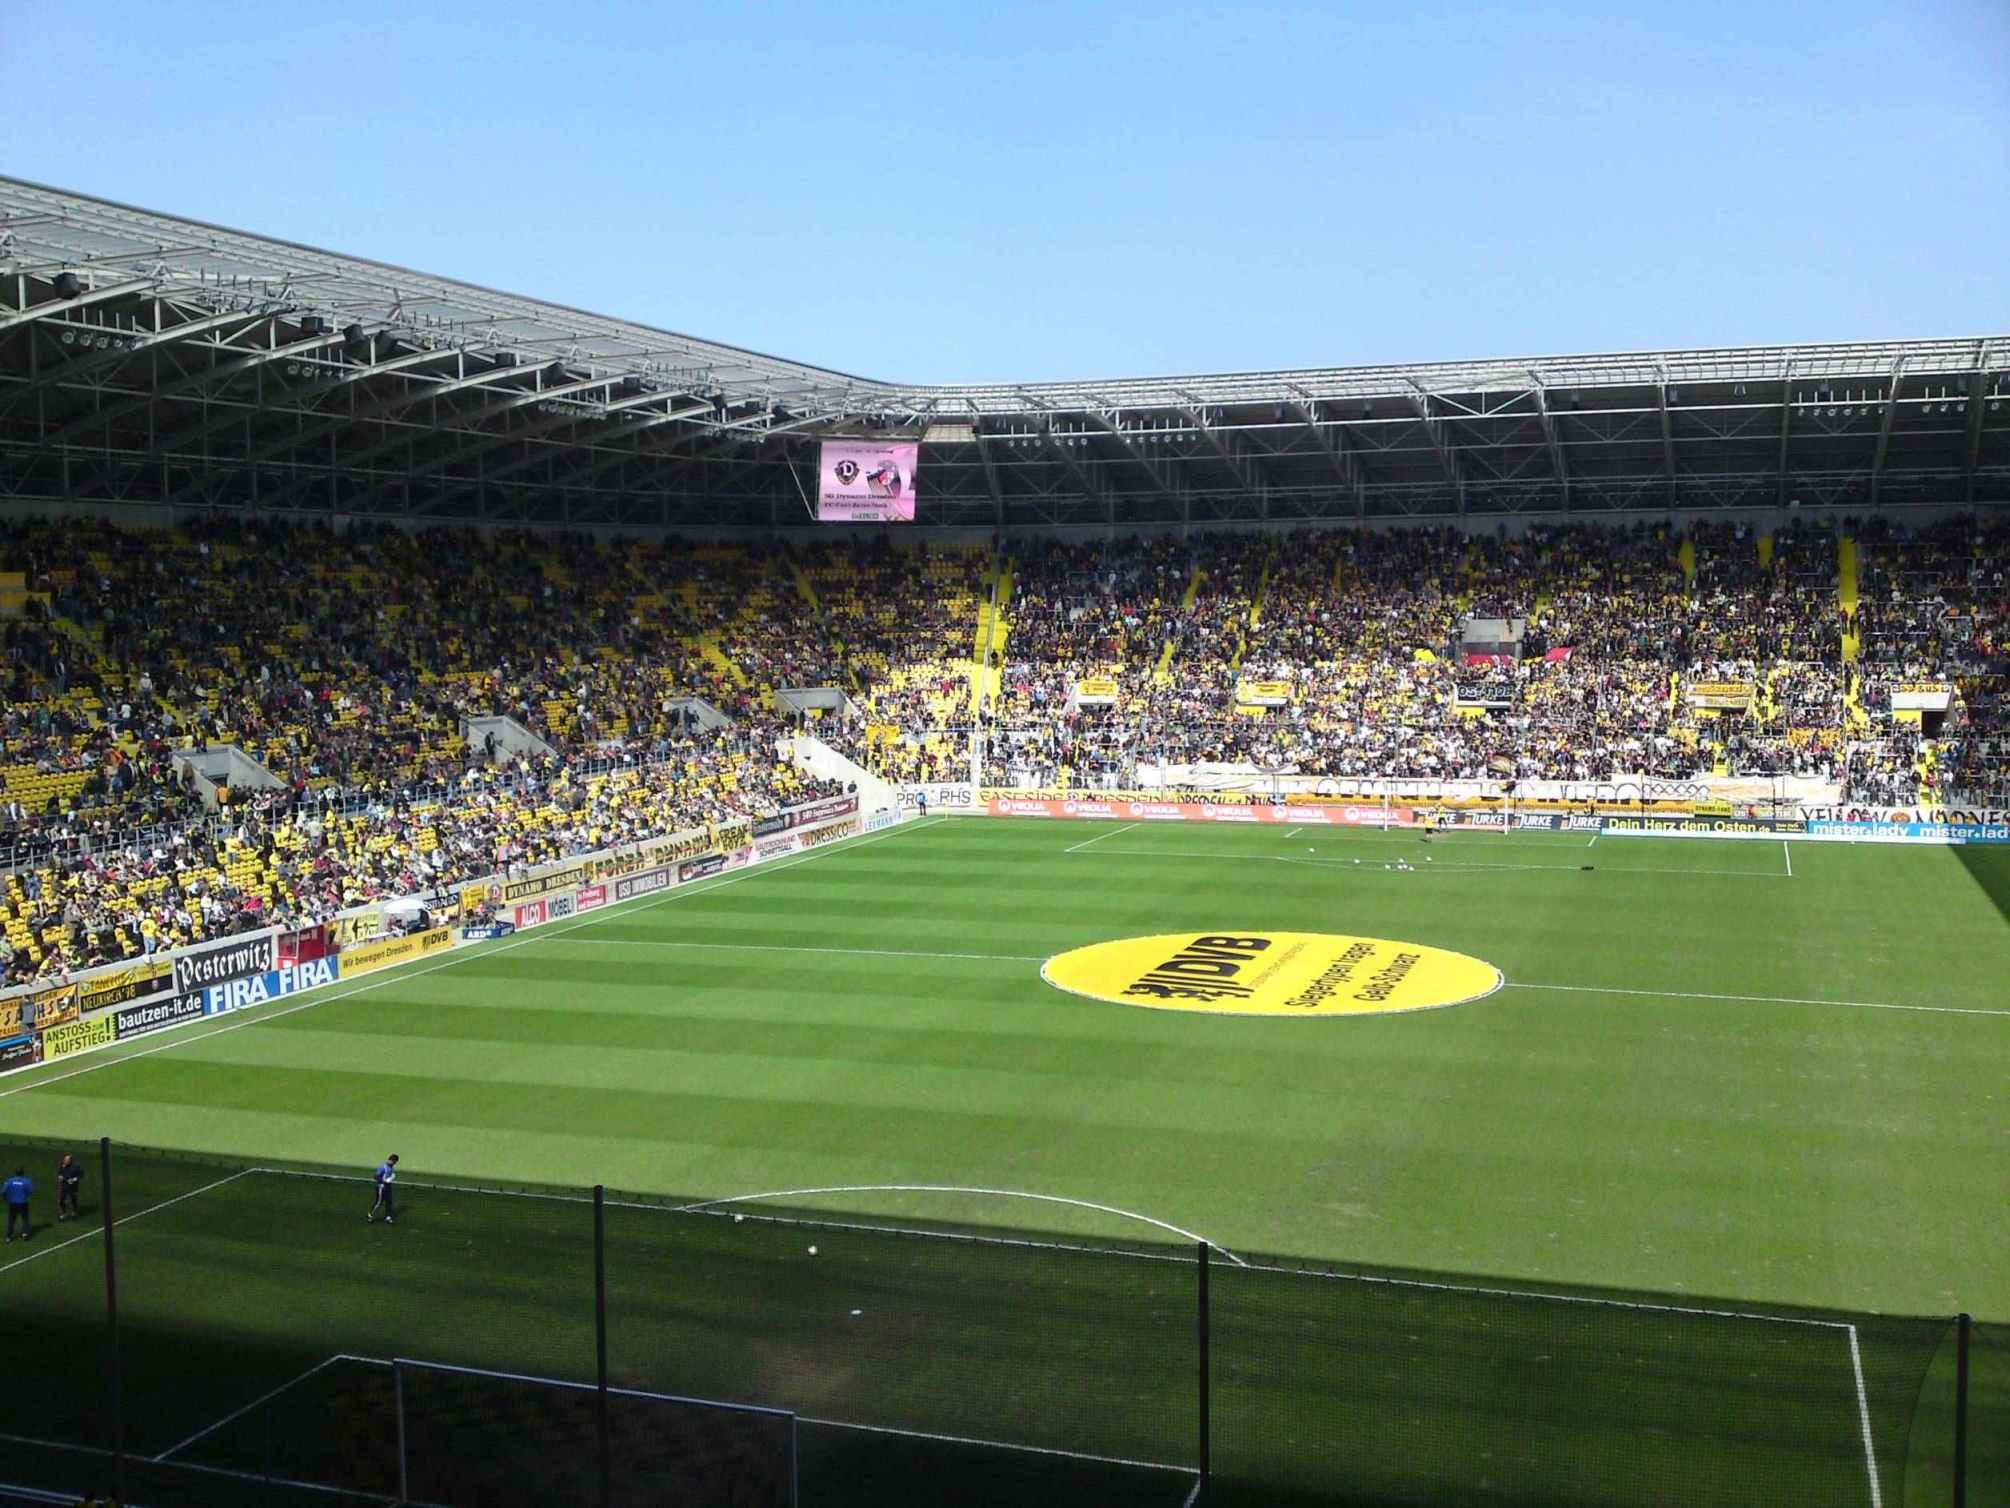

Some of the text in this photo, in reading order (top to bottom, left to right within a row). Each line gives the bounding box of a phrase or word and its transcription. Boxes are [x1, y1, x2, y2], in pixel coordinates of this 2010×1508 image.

[1520, 814, 1552, 828] JURKE
[1569, 815, 1602, 828] JURKE
[1608, 817, 1640, 829] Dein
[1644, 818, 1675, 831] Herz
[1679, 819, 1711, 831] dem
[177, 942, 270, 992] Pesterwitz
[342, 930, 448, 969] Wir bewegen Dresden DVB
[208, 974, 269, 1013] FIRA
[278, 959, 334, 995] FIRA
[1284, 963, 1353, 1008] Siegertypen
[1353, 953, 1421, 1002] Gelb-Schwarz
[118, 993, 202, 1030] bautzen-it.de
[46, 1020, 92, 1042] ANSTOSS
